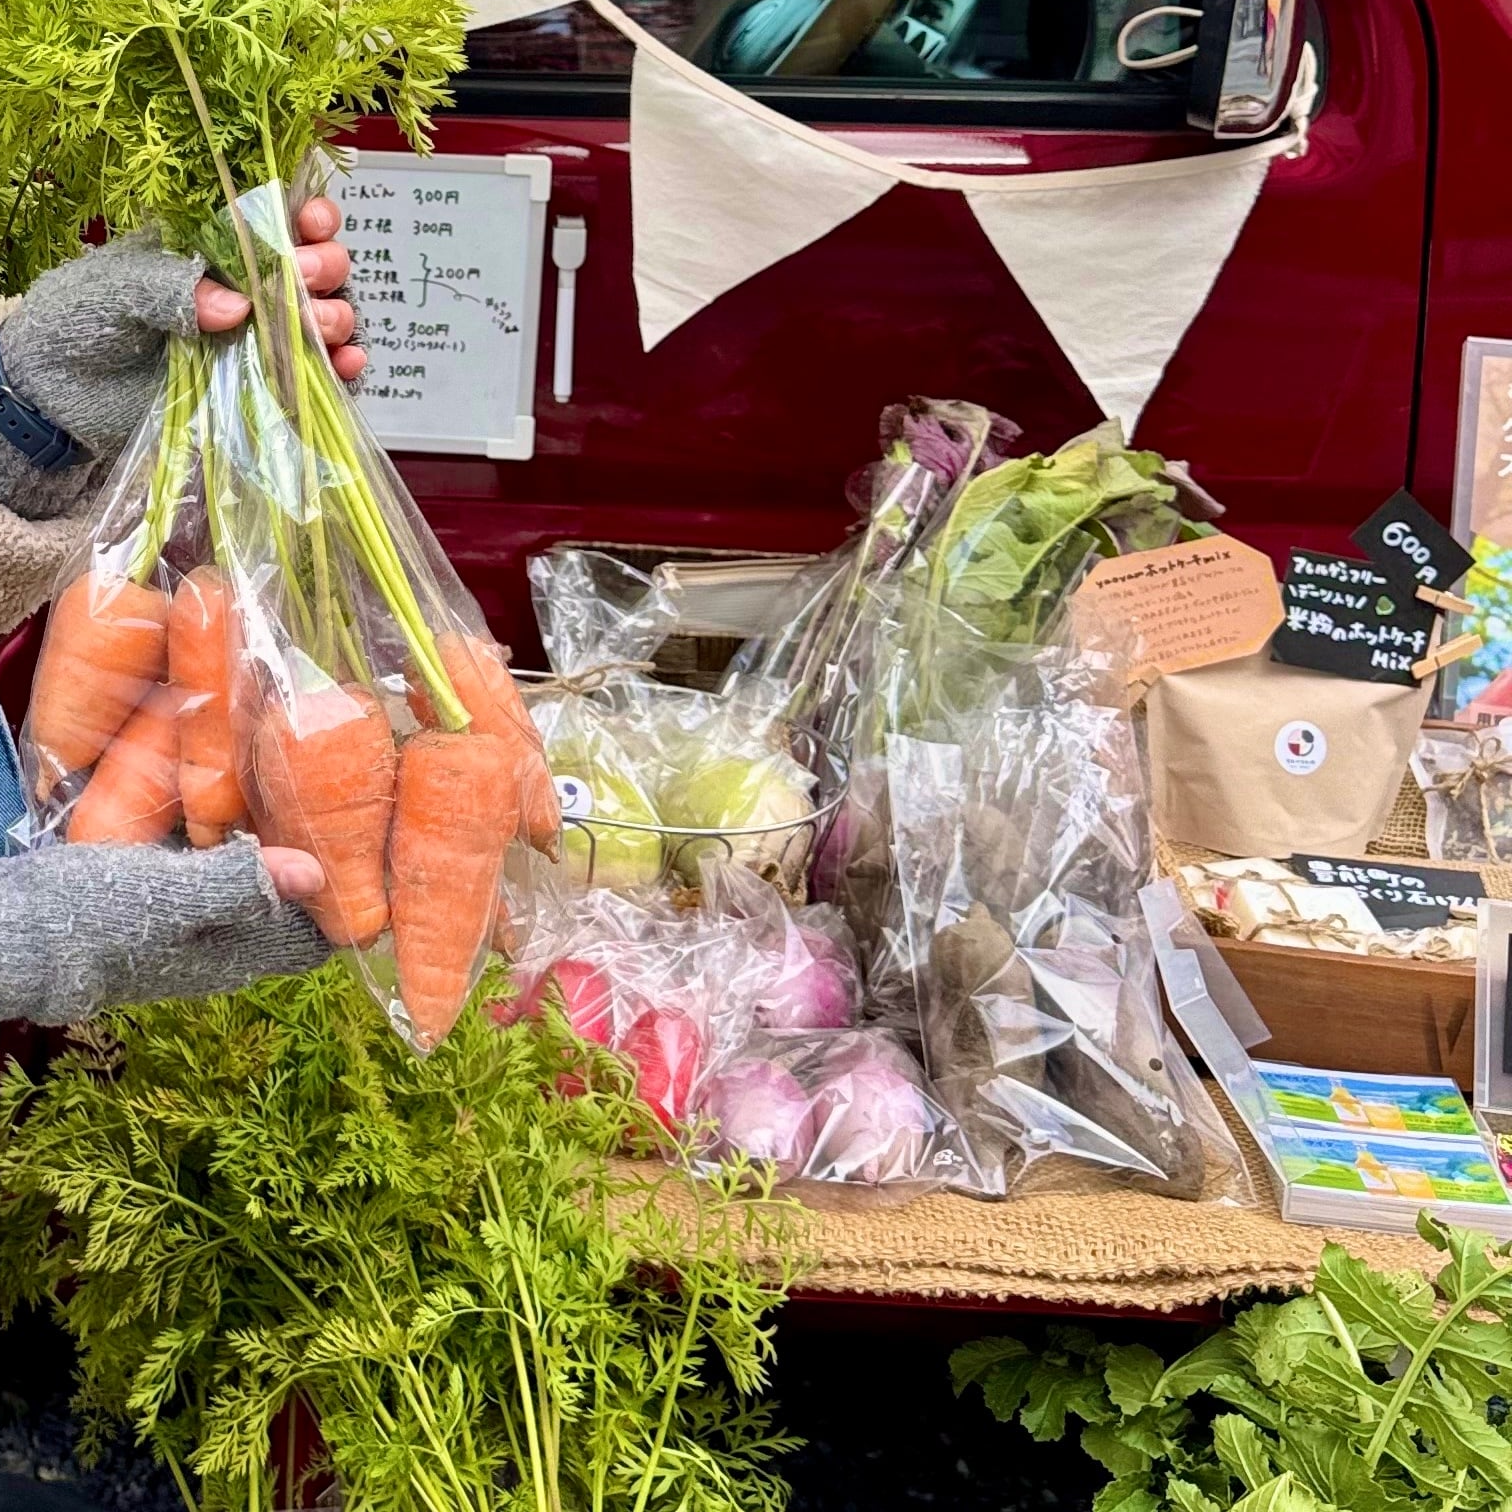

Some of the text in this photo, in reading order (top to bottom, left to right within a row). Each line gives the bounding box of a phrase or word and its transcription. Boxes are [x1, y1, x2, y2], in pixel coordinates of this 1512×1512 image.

[413, 188, 460, 205] 300円
[413, 220, 453, 237] 300円
[434, 267, 481, 281] 200円
[408, 320, 450, 337] 300円
[388, 364, 426, 378] 300円
[1382, 521, 1438, 585] 600円
